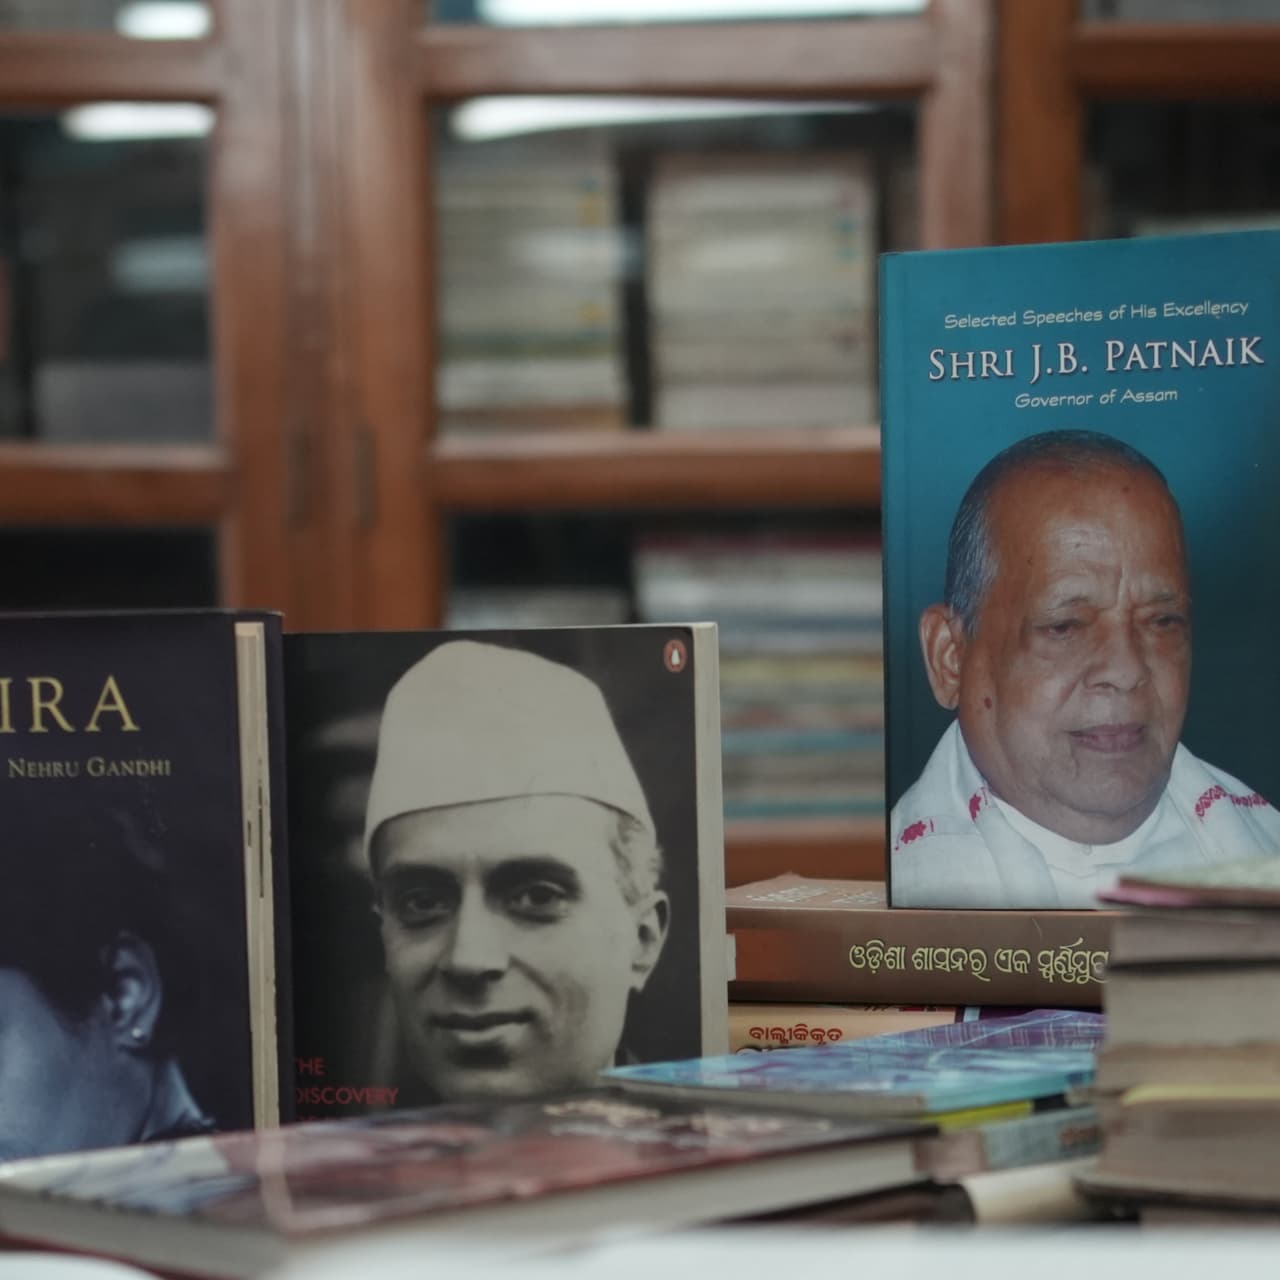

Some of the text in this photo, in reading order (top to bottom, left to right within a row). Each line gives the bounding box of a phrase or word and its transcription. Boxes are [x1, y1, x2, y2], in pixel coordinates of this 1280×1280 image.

[944, 300, 1249, 329] Selected Speeches of His Excellency
[929, 336, 1265, 384] SHRI J.B. PATNAIK
[1014, 388, 1178, 409] Governor of Assam
[7, 757, 80, 779] NEHRU
[86, 755, 172, 778] GANDHI
[911, 946, 991, 982] ଶାସନର
[994, 947, 1031, 974] ଏକ
[296, 1057, 326, 1077] HE
